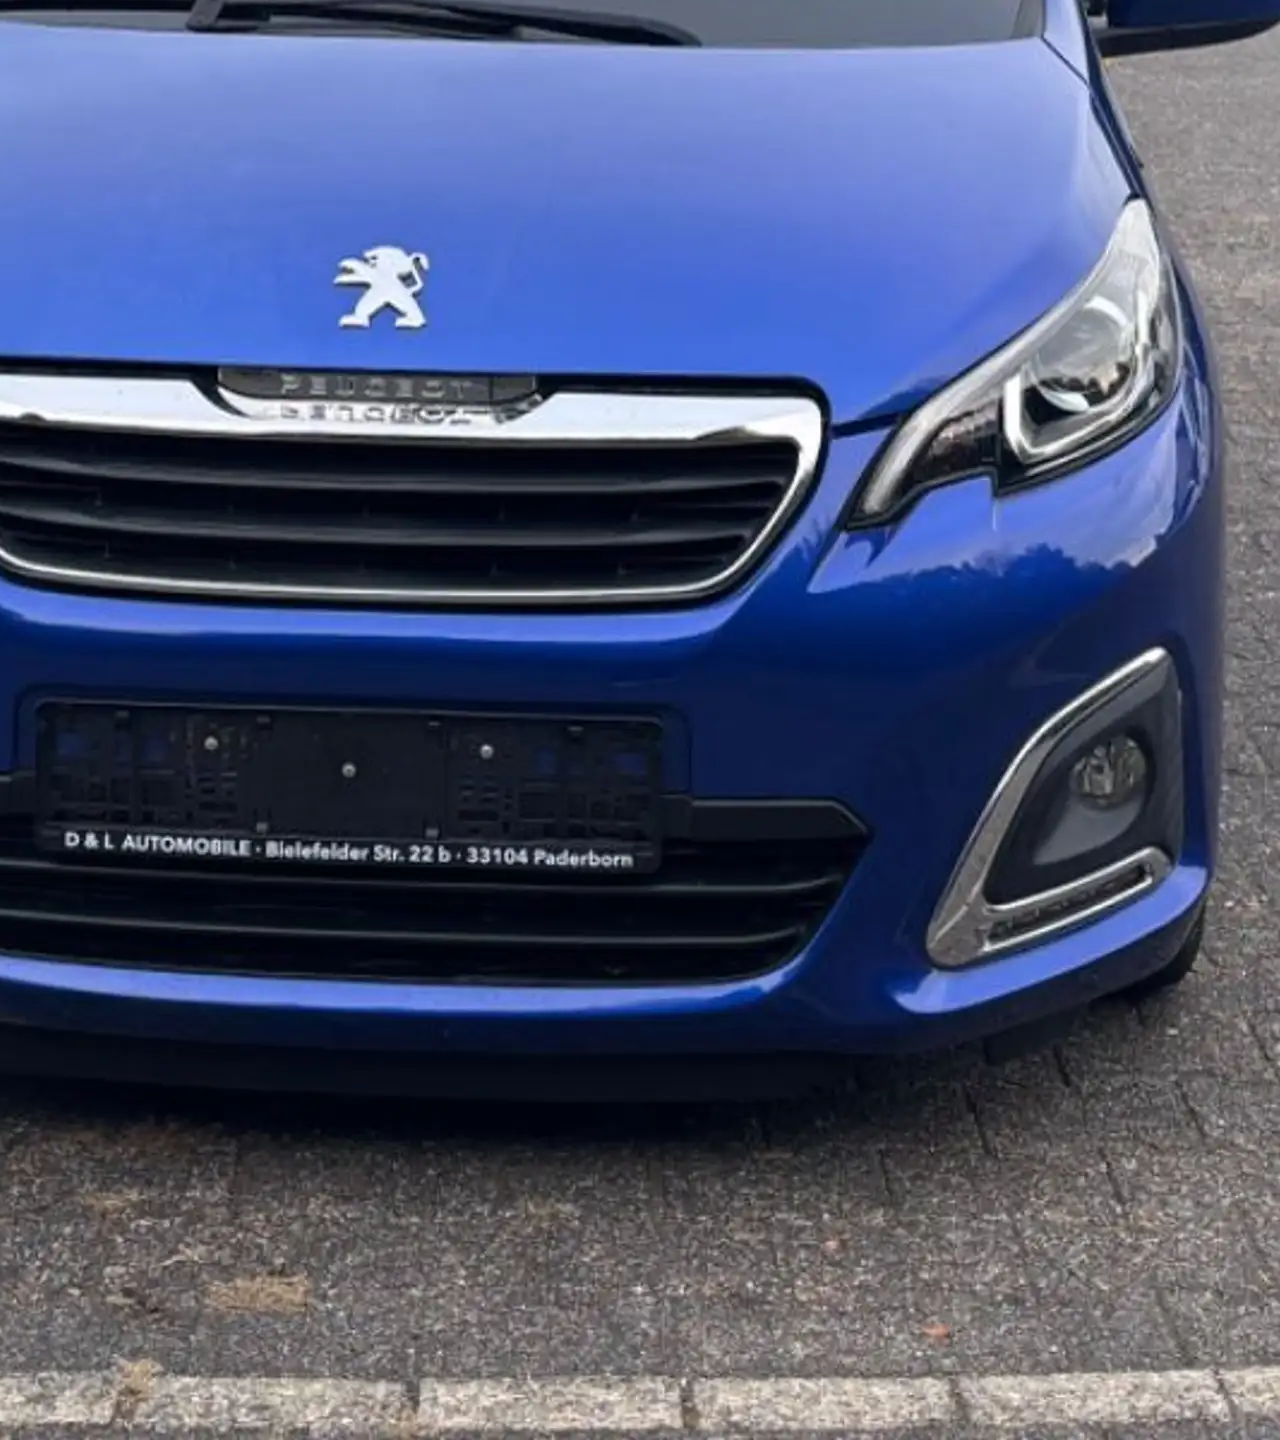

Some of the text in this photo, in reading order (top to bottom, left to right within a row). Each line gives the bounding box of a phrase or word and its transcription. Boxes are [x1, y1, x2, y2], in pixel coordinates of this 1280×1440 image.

[65, 832, 635, 868] D & L AUTOMOBILE Bielefelder Str. 22 b 33104 Paderborn
